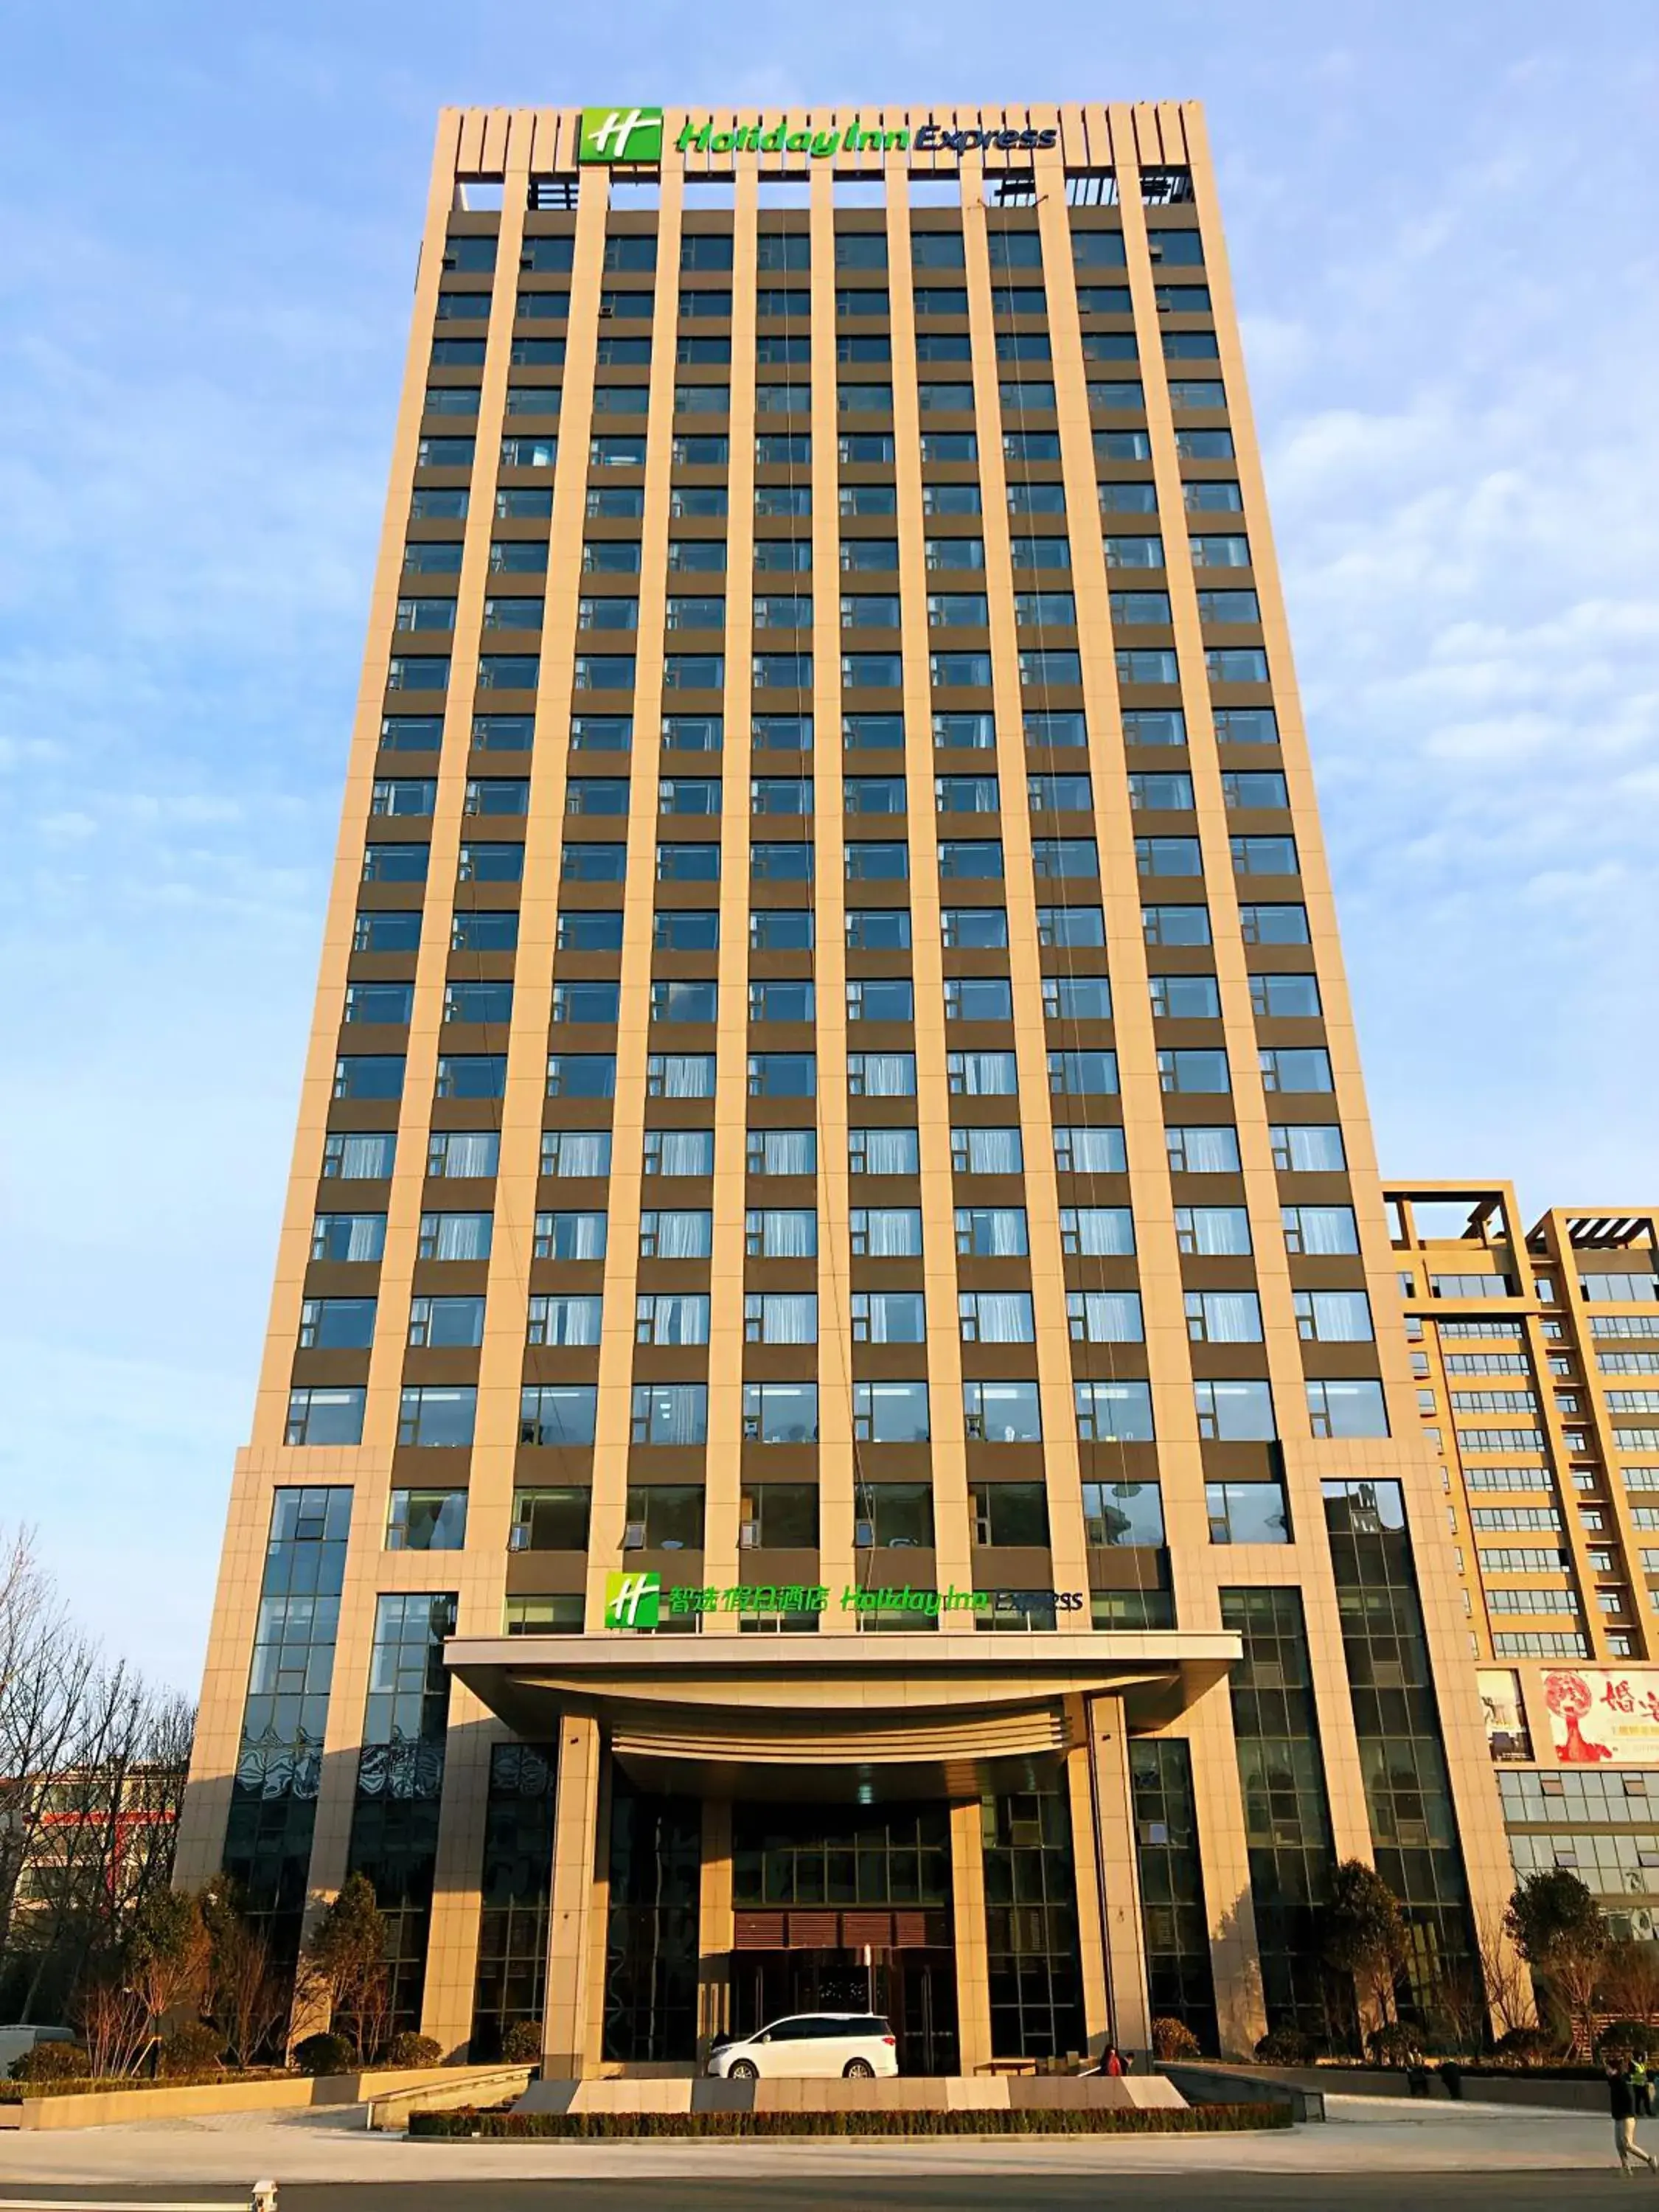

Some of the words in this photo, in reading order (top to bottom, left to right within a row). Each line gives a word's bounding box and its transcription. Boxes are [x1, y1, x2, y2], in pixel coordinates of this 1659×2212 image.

[674, 122, 841, 158] Holiday
[841, 121, 909, 152] Inn
[912, 125, 1057, 157] Express
[669, 1585, 831, 1613] 智选假日酒店
[840, 1584, 942, 1616] Holiday
[945, 1584, 989, 1611] Inn
[995, 1589, 1083, 1616] Exess
